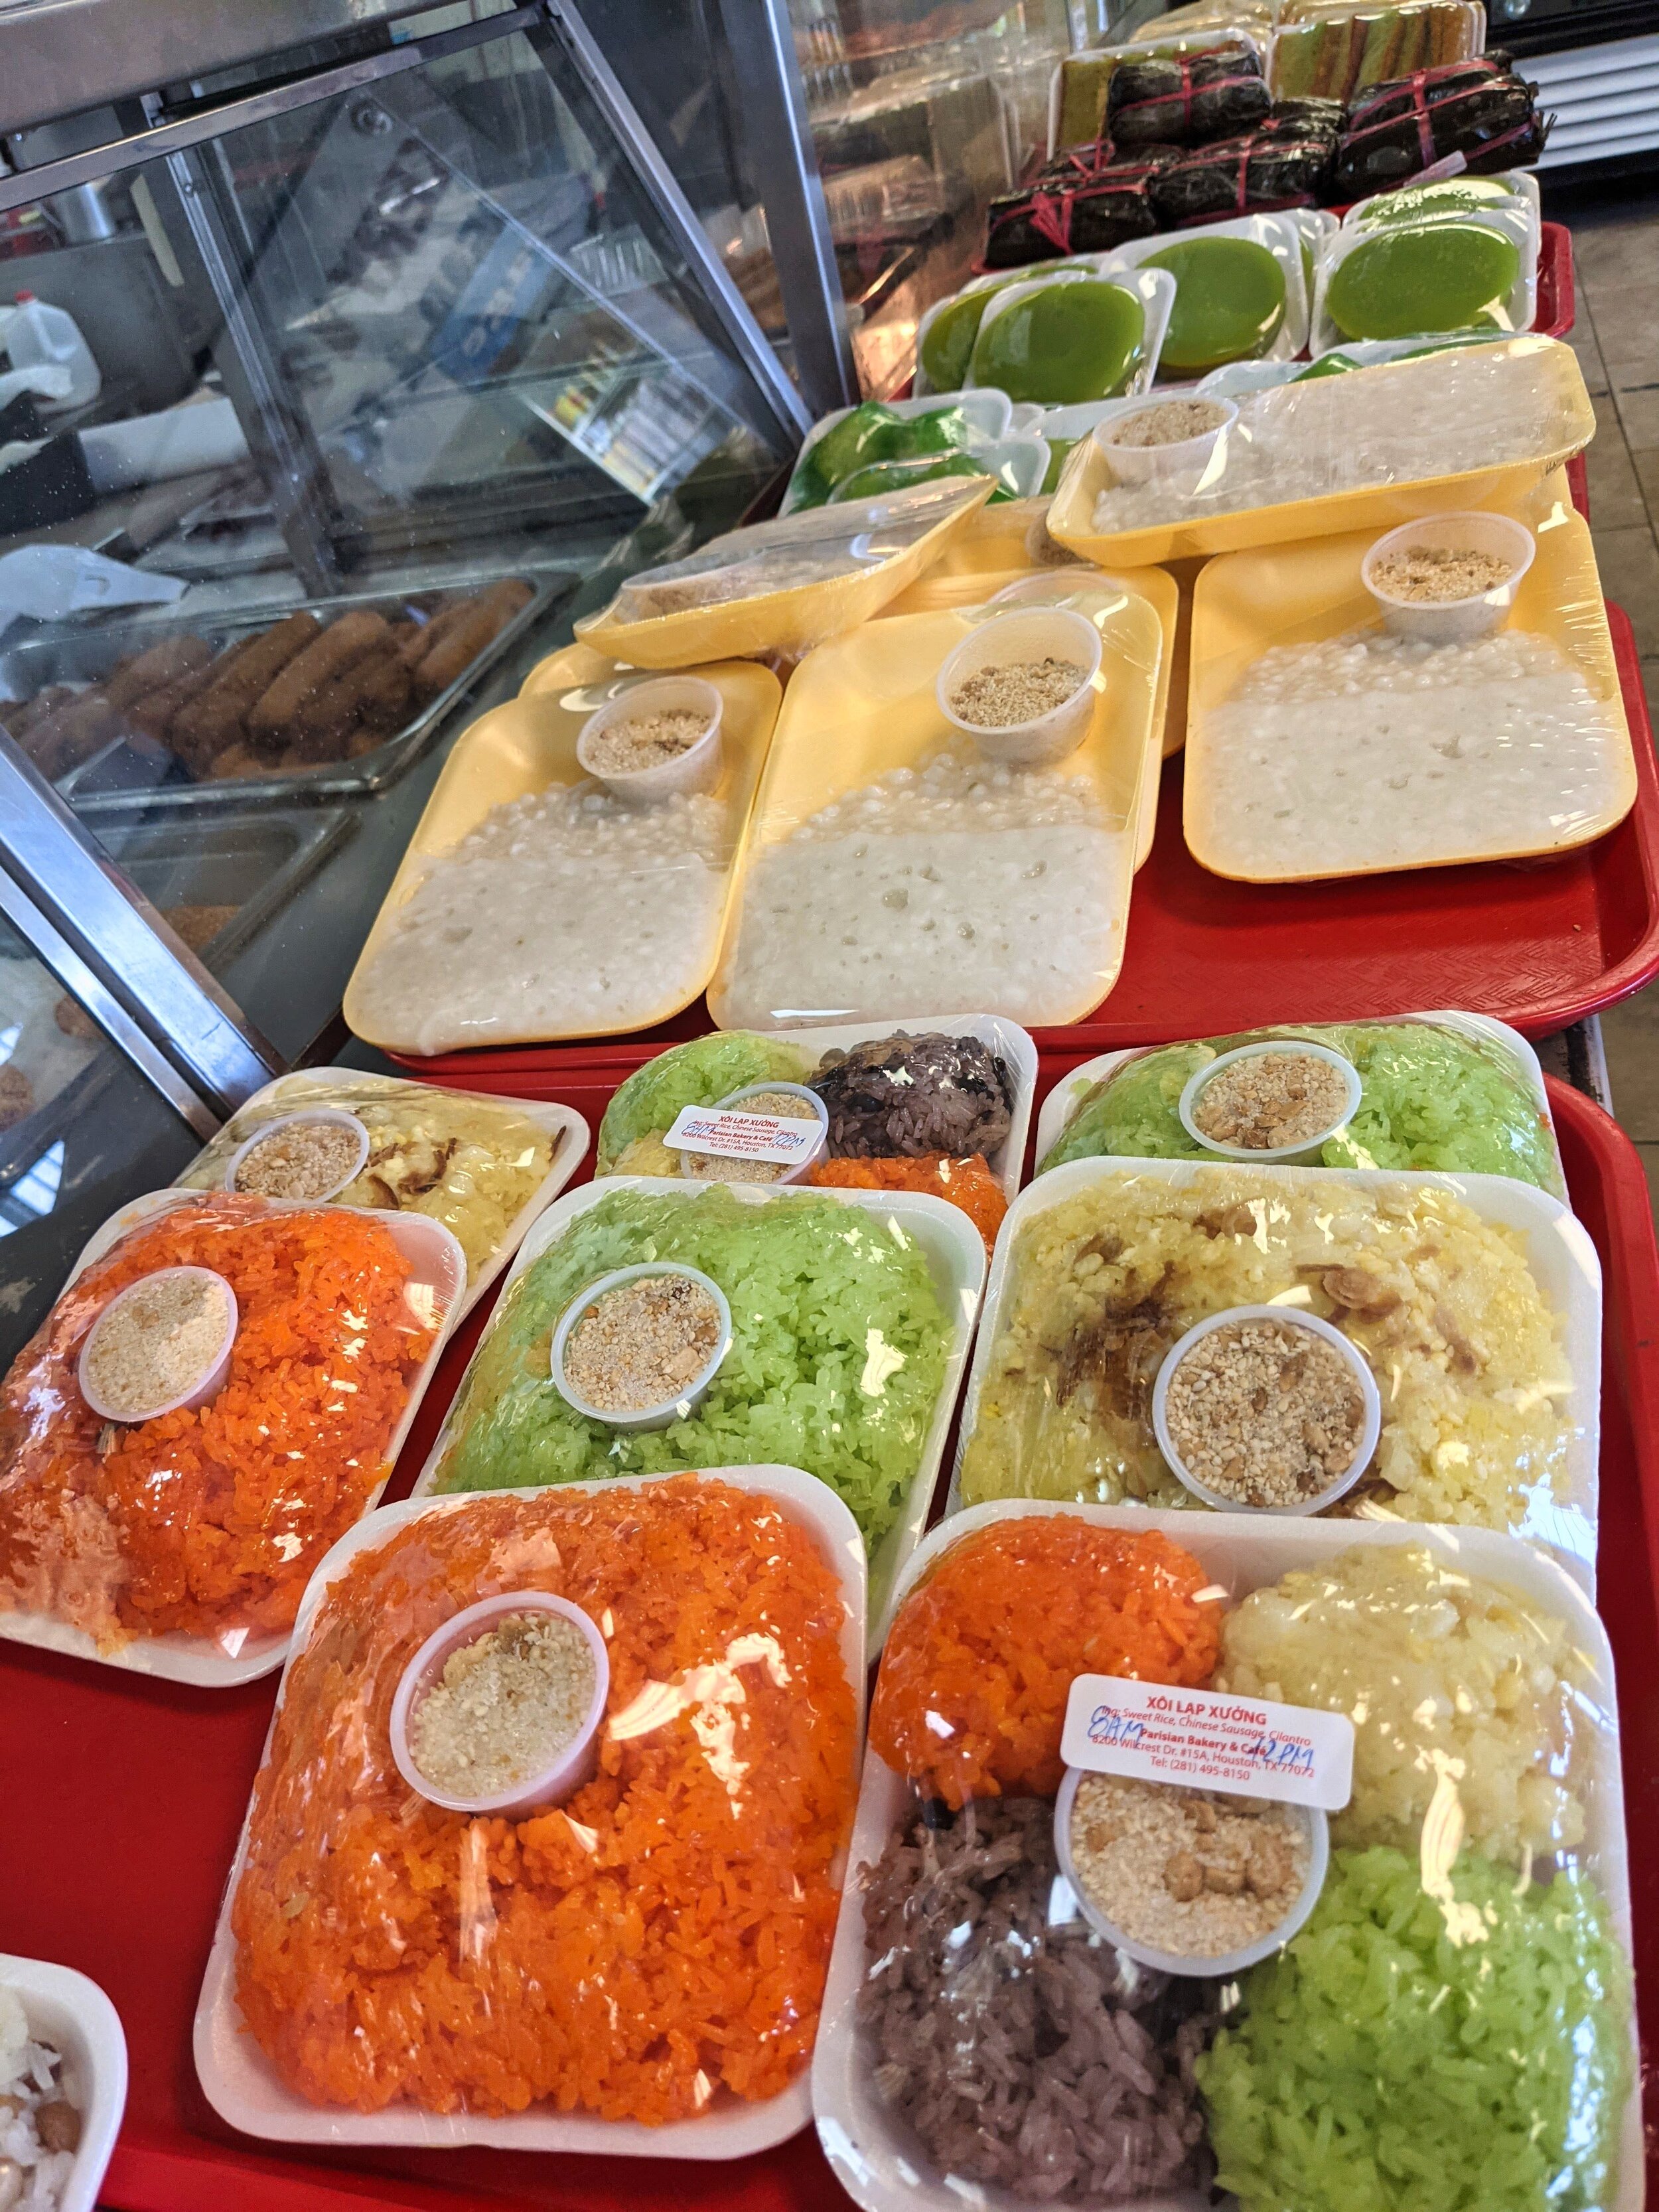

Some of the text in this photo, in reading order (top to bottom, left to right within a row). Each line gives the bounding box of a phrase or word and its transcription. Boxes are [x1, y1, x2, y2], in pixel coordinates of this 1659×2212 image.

[1147, 1696, 1173, 1712] XÔI
[1176, 1700, 1205, 1715] LAP
[1087, 1705, 1145, 1748] 8AM
[1102, 1706, 1311, 1746] Ing: Sweet Rice, Chinese Sausage, Cilantro
[1141, 1728, 1266, 1755] Parisian Bakery & Café
[1092, 1734, 1315, 1777] 8200 Wilcrest Dr. #15A, Houston, TX 77072
[1150, 1755, 1250, 1780] Tel: (281) 495-8150
